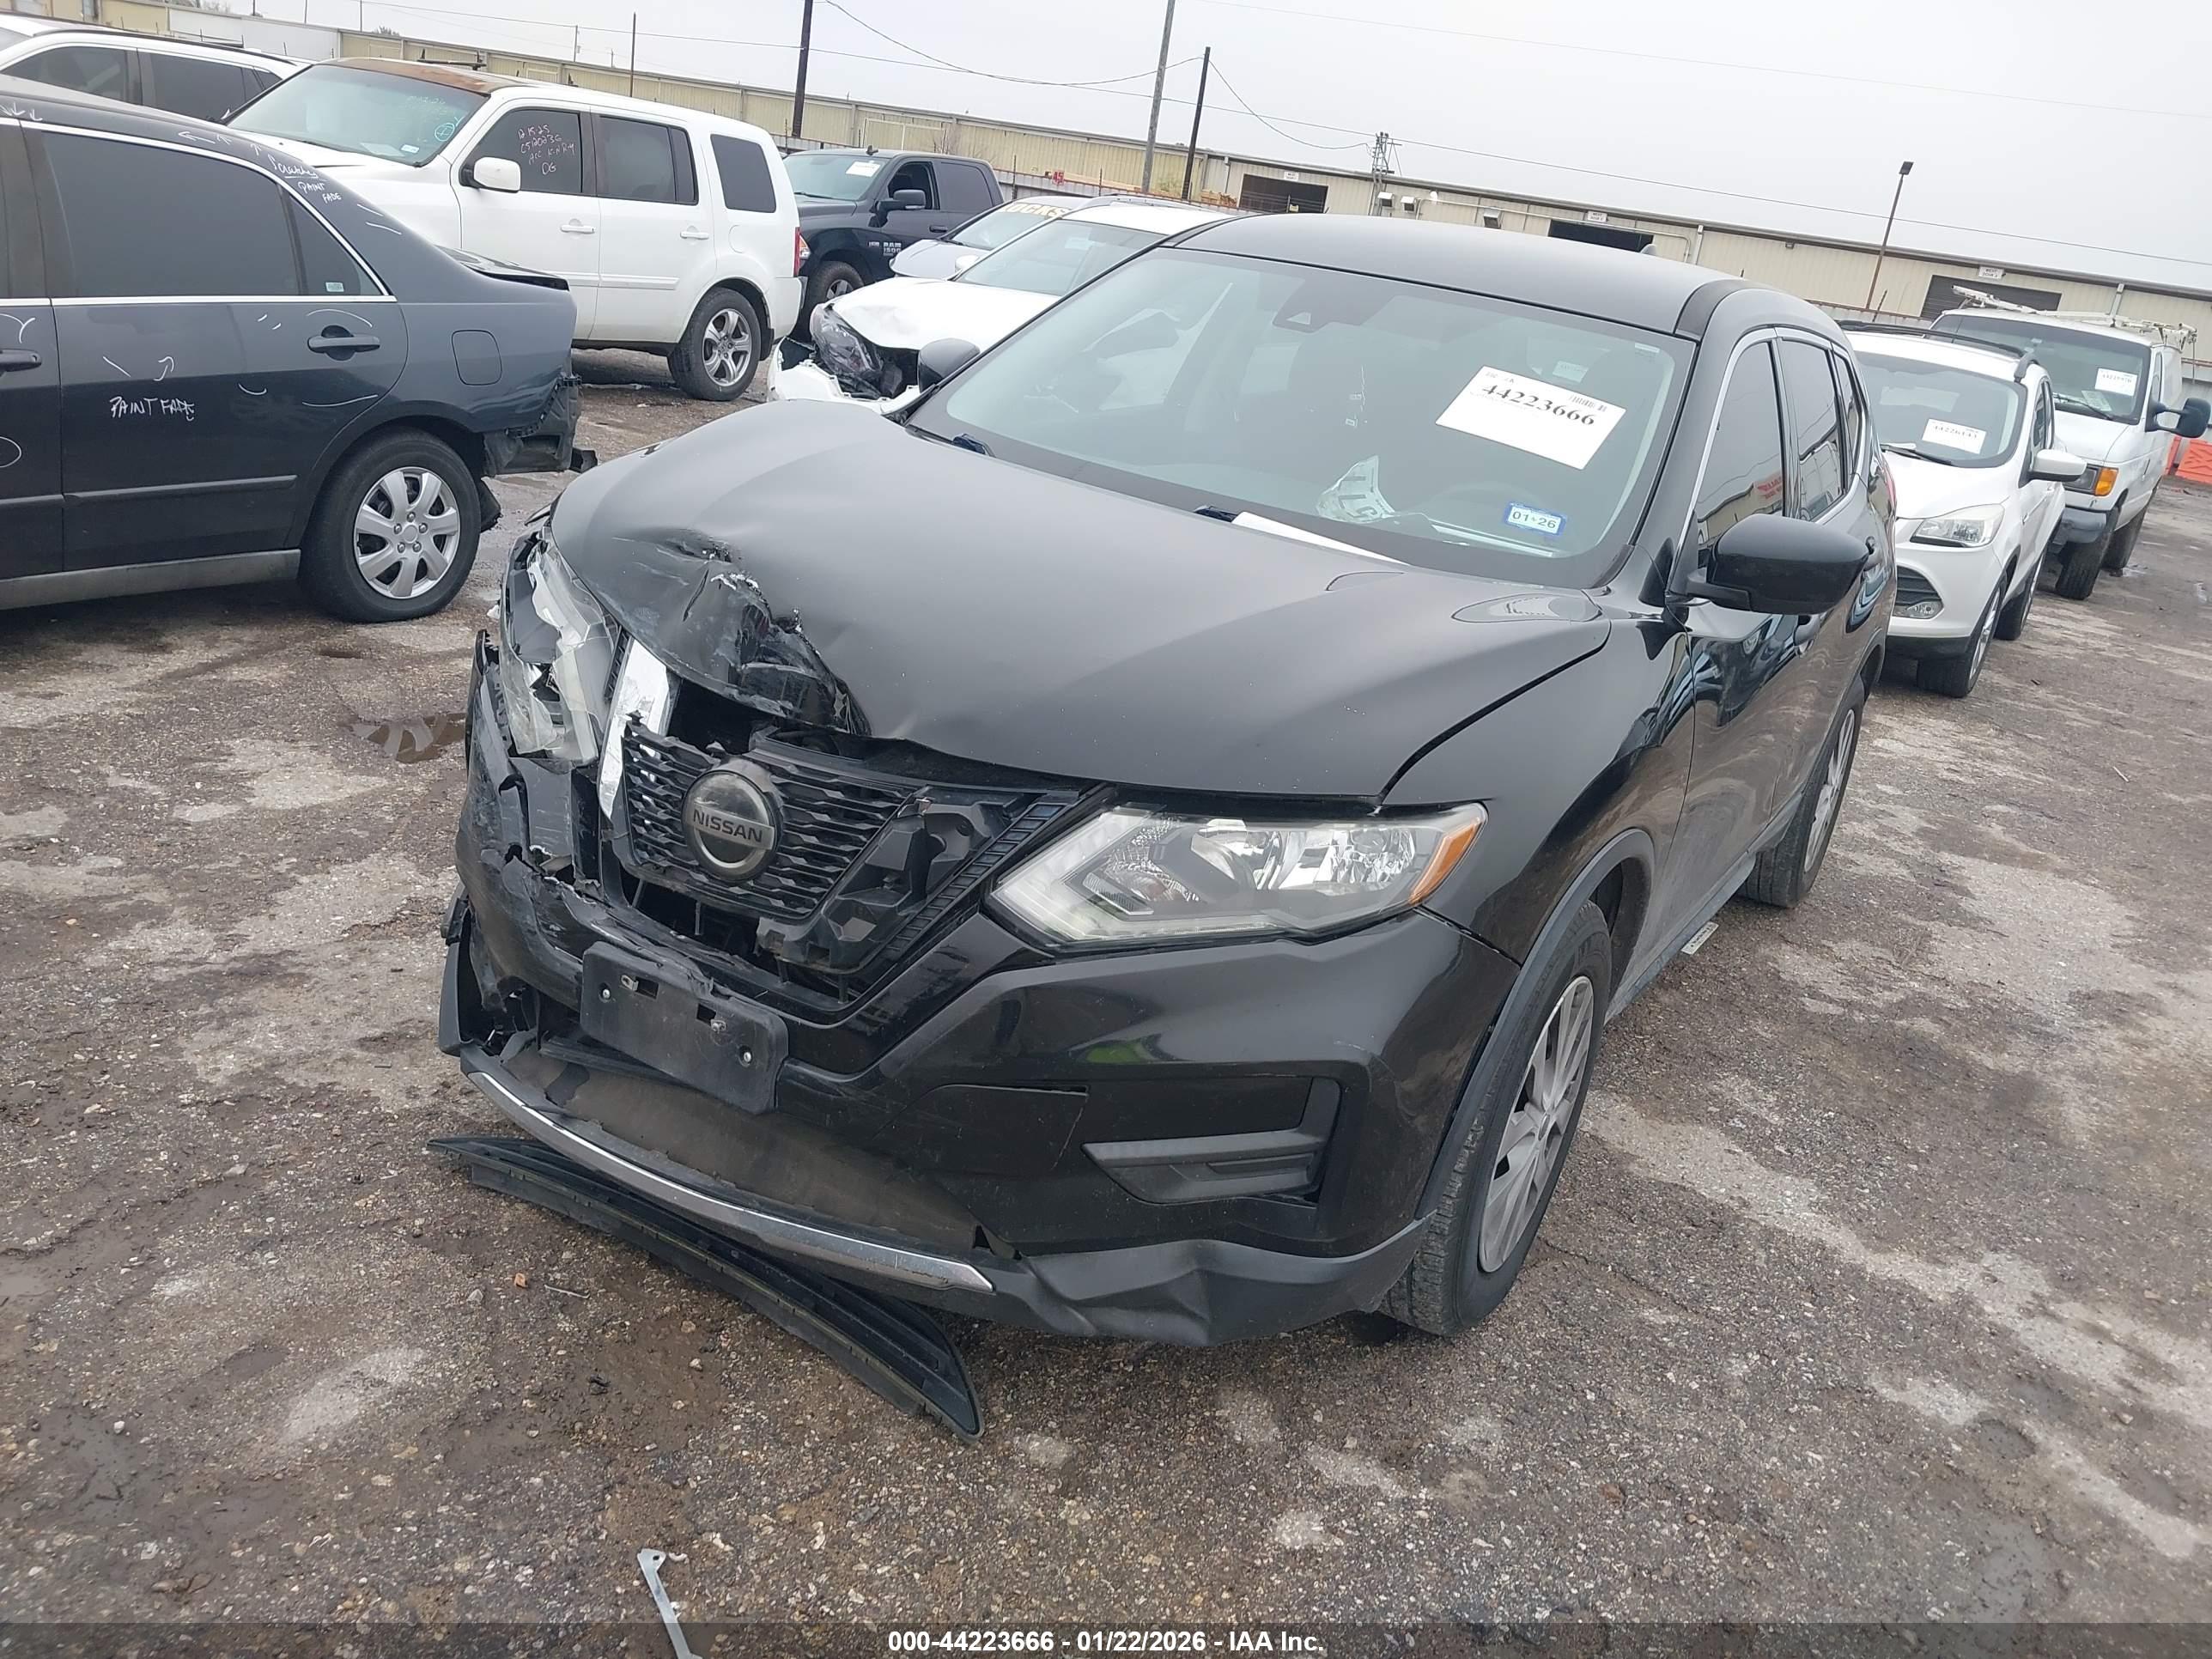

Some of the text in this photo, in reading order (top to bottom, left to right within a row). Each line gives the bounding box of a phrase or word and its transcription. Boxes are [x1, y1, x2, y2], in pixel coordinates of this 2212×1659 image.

[1053, 171, 1065, 183] 45
[109, 396, 158, 418] PAINT
[1482, 385, 1595, 425] 44223666
[693, 809, 763, 842] NISSAN
